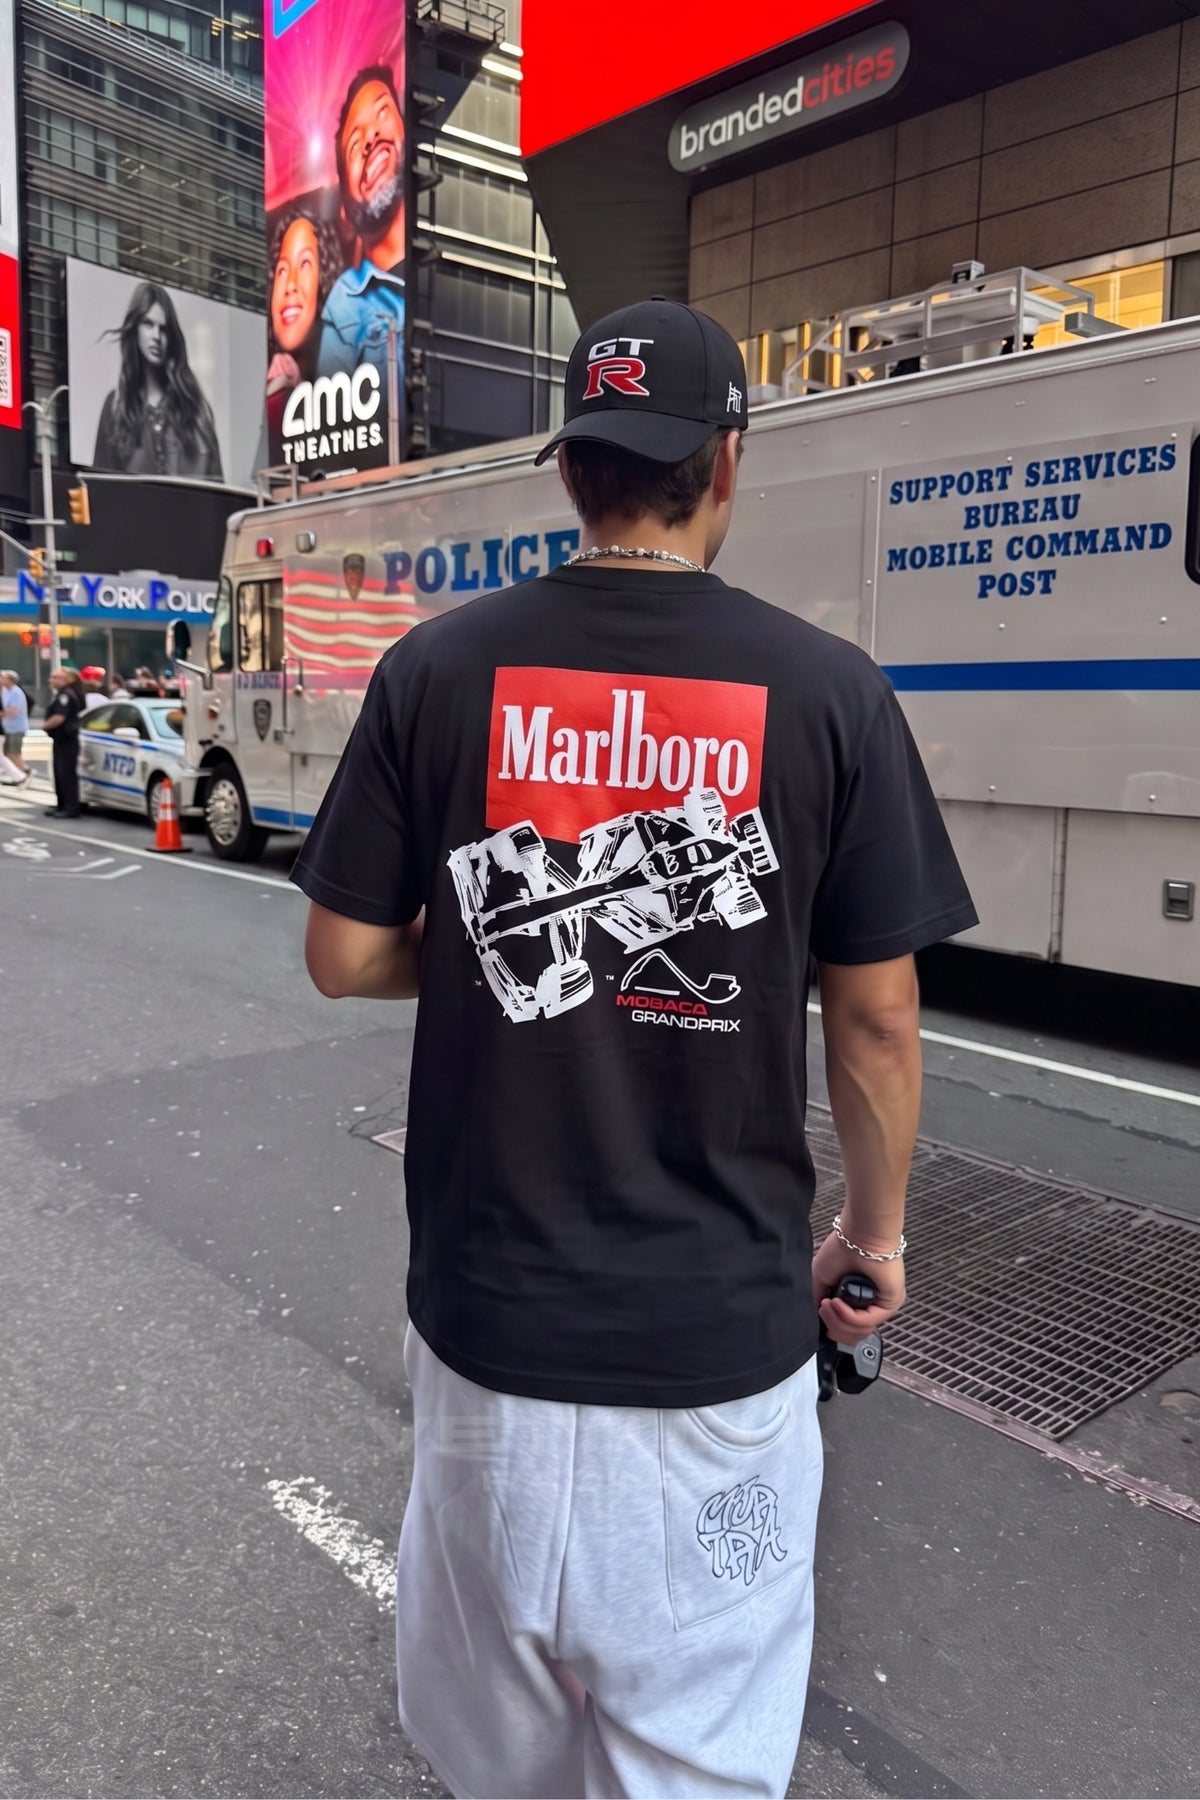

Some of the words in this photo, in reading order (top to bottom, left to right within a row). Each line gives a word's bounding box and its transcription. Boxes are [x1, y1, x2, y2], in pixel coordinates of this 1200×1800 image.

[588, 337, 654, 361] GT
[582, 357, 650, 400] R
[889, 466, 1013, 505] SUPPORT
[1025, 444, 1176, 488] SERVICES
[963, 494, 1081, 530] BUREAU
[887, 539, 993, 572] MOBILE
[1006, 522, 1173, 561] COMMAND
[977, 569, 1057, 599] POST
[498, 688, 749, 797] Marlboro
[103, 752, 136, 777] NYPD
[631, 1009, 742, 1033] GRANDPRIX
